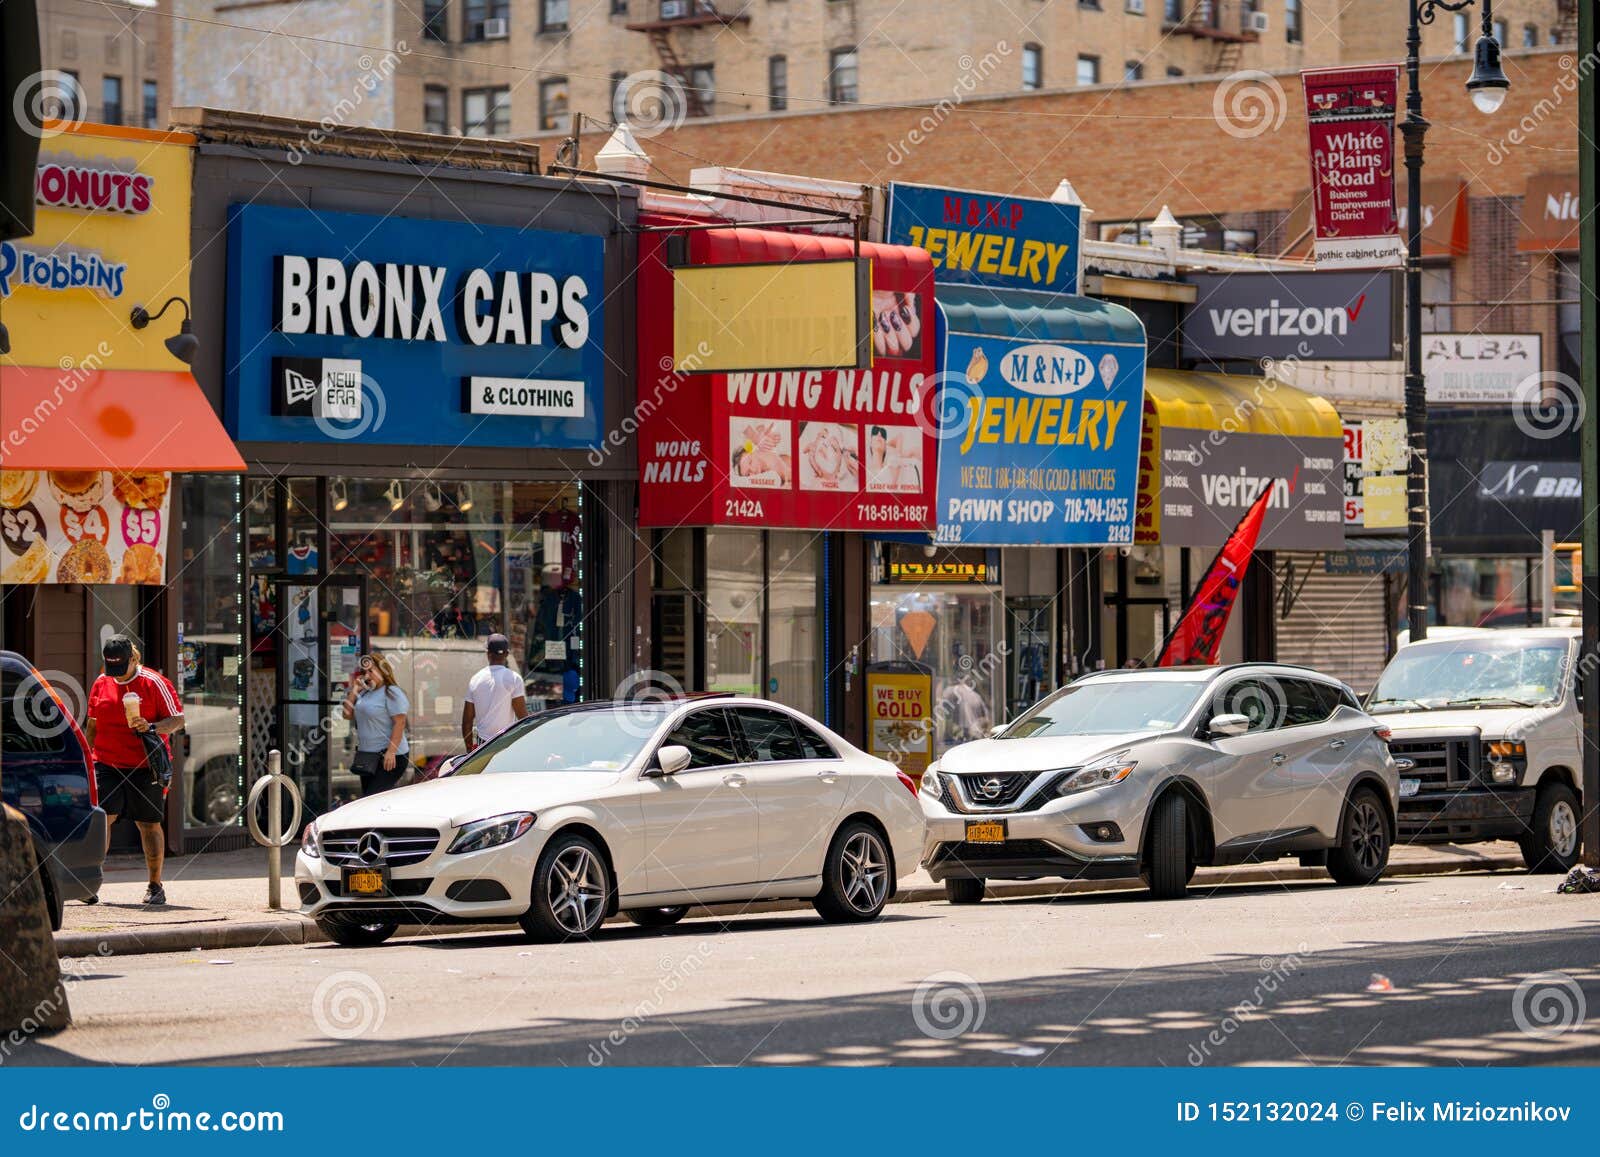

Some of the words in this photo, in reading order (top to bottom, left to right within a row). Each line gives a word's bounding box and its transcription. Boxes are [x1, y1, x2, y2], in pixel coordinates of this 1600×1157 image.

[1326, 132, 1384, 151] White
[1328, 151, 1382, 168] Plains
[1329, 168, 1374, 186] Road
[35, 165, 151, 212] ONUTS
[1329, 190, 1368, 199] Business
[1330, 199, 1391, 211] Improvement
[1331, 211, 1365, 221] District
[1317, 249, 1343, 261] gothic
[1346, 248, 1377, 259] cabinet
[1379, 247, 1400, 258] craft
[280, 255, 447, 342] BRONX
[460, 267, 590, 350] CAPS
[1209, 299, 1348, 336] verizon
[1426, 340, 1528, 361] ALBA
[1010, 354, 1028, 382] M
[1033, 355, 1047, 384] &
[327, 372, 356, 387] NEW
[326, 390, 357, 405] ERA
[483, 390, 495, 405] &
[498, 390, 574, 408] CLOTHING
[726, 371, 822, 409] WONG
[833, 370, 924, 415] NAILS
[960, 397, 1128, 455] JEWELRY
[655, 440, 701, 457] WONG
[643, 460, 707, 484] NAILS
[961, 466, 974, 488] WE
[975, 466, 993, 489] SELL
[1046, 468, 1070, 491] GOLD
[1079, 468, 1116, 491] WATCHES
[726, 500, 764, 518] 2142A
[857, 505, 929, 522] 718-518-1887
[948, 498, 1003, 522] PAWN
[1007, 499, 1056, 524] SHOP
[1063, 498, 1128, 523] 718-794-1255
[3, 508, 40, 543] $2
[64, 511, 106, 543] $4
[126, 510, 158, 544] $5
[937, 525, 962, 541] 2142
[1107, 526, 1130, 541] 2142
[877, 690, 895, 699] WE
[898, 690, 922, 700] BUY
[876, 701, 923, 718] GOLD
